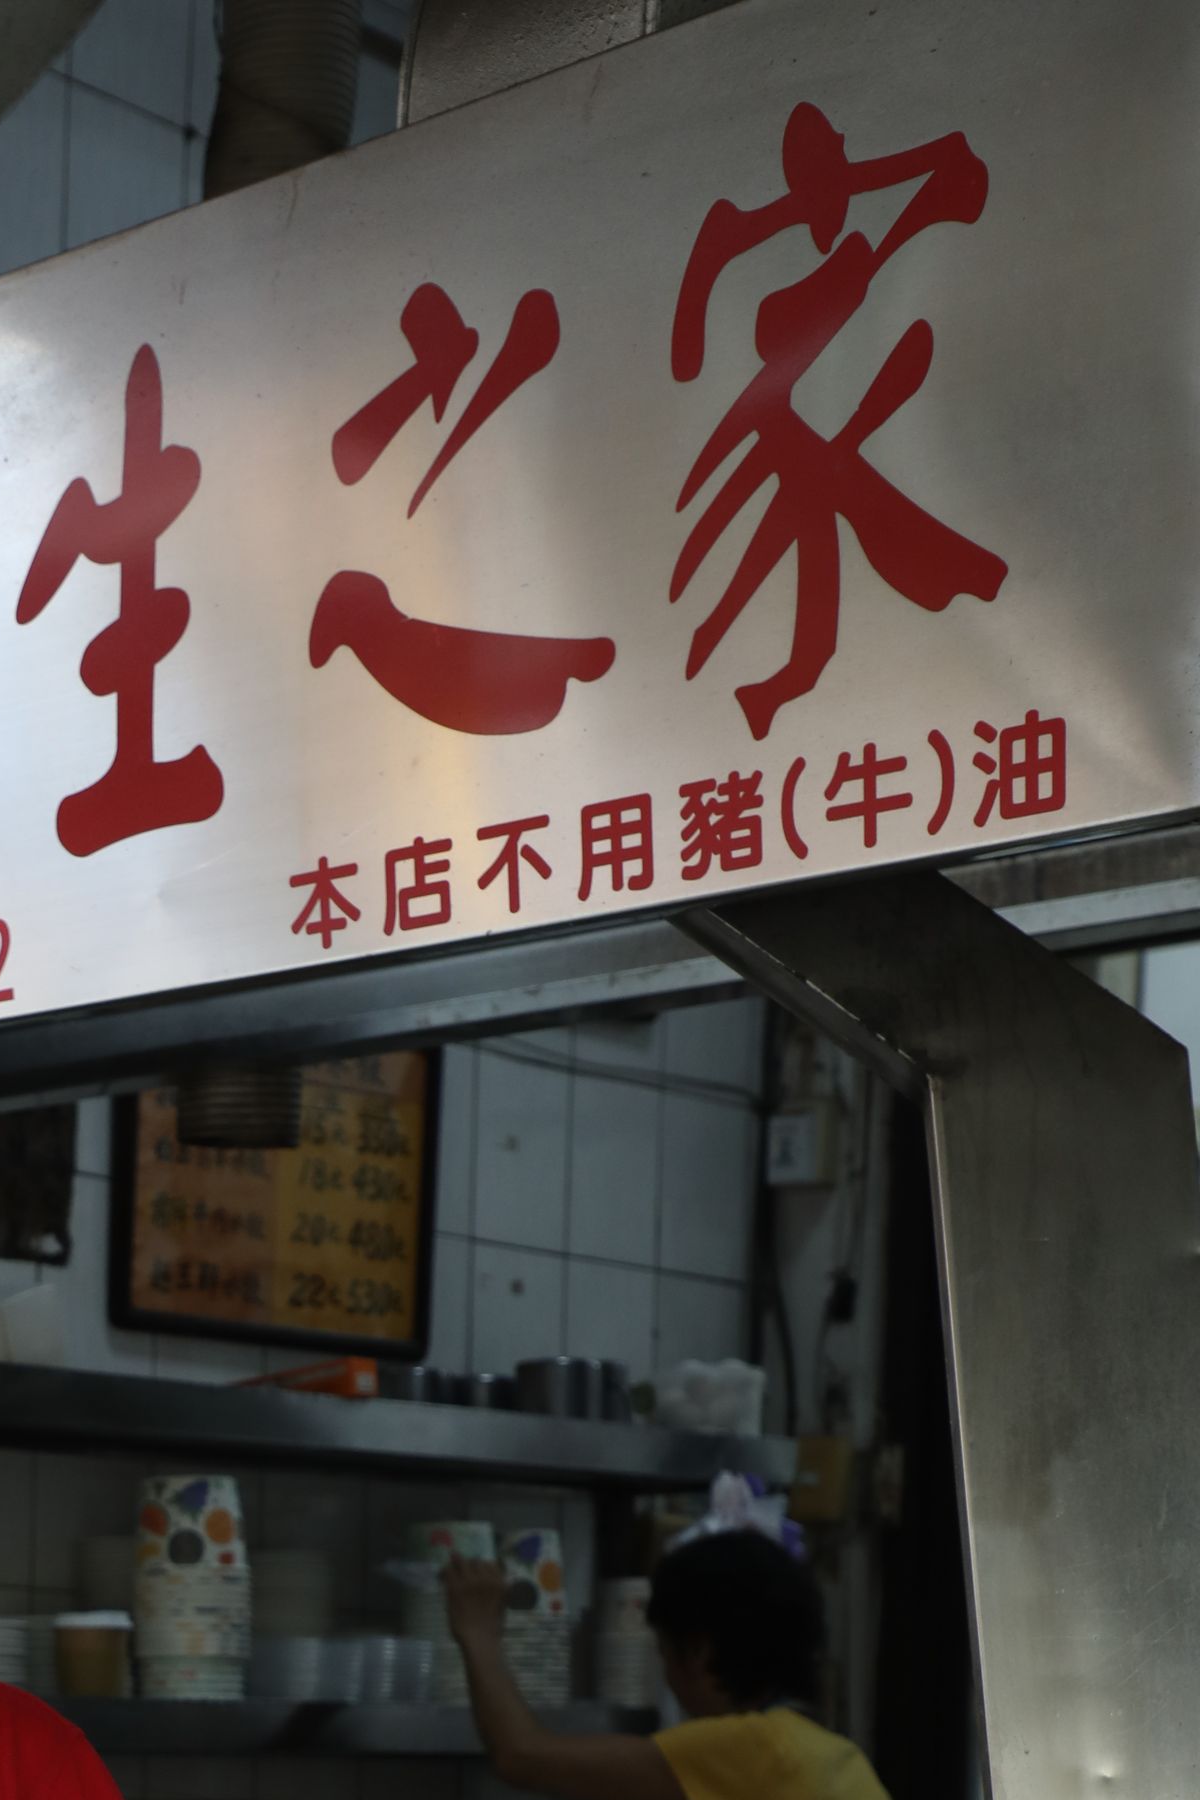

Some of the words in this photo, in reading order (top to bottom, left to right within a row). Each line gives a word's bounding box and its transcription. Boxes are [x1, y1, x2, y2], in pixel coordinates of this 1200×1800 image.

[288, 709, 1067, 950] 本店不用豬(牛)油
